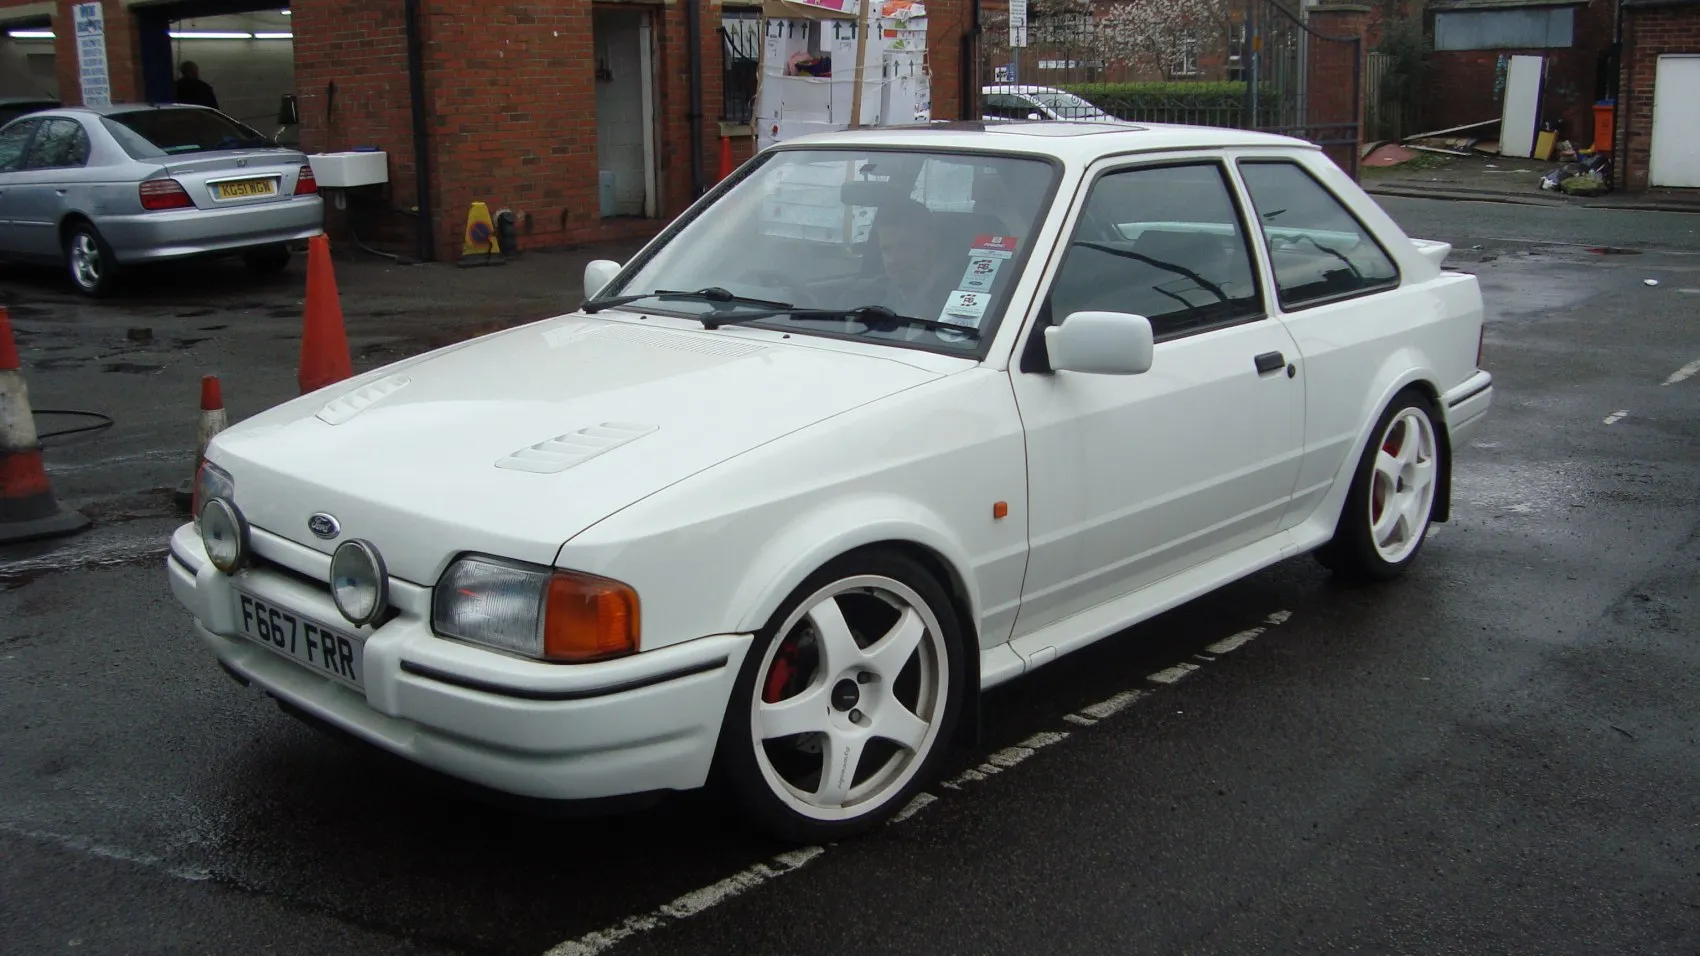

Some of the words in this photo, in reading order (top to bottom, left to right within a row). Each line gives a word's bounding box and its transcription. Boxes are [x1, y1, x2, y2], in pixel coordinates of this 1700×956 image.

[222, 183, 247, 197] KG51
[250, 180, 271, 194] WGW
[240, 594, 297, 654] F667
[303, 622, 356, 681] FRR
